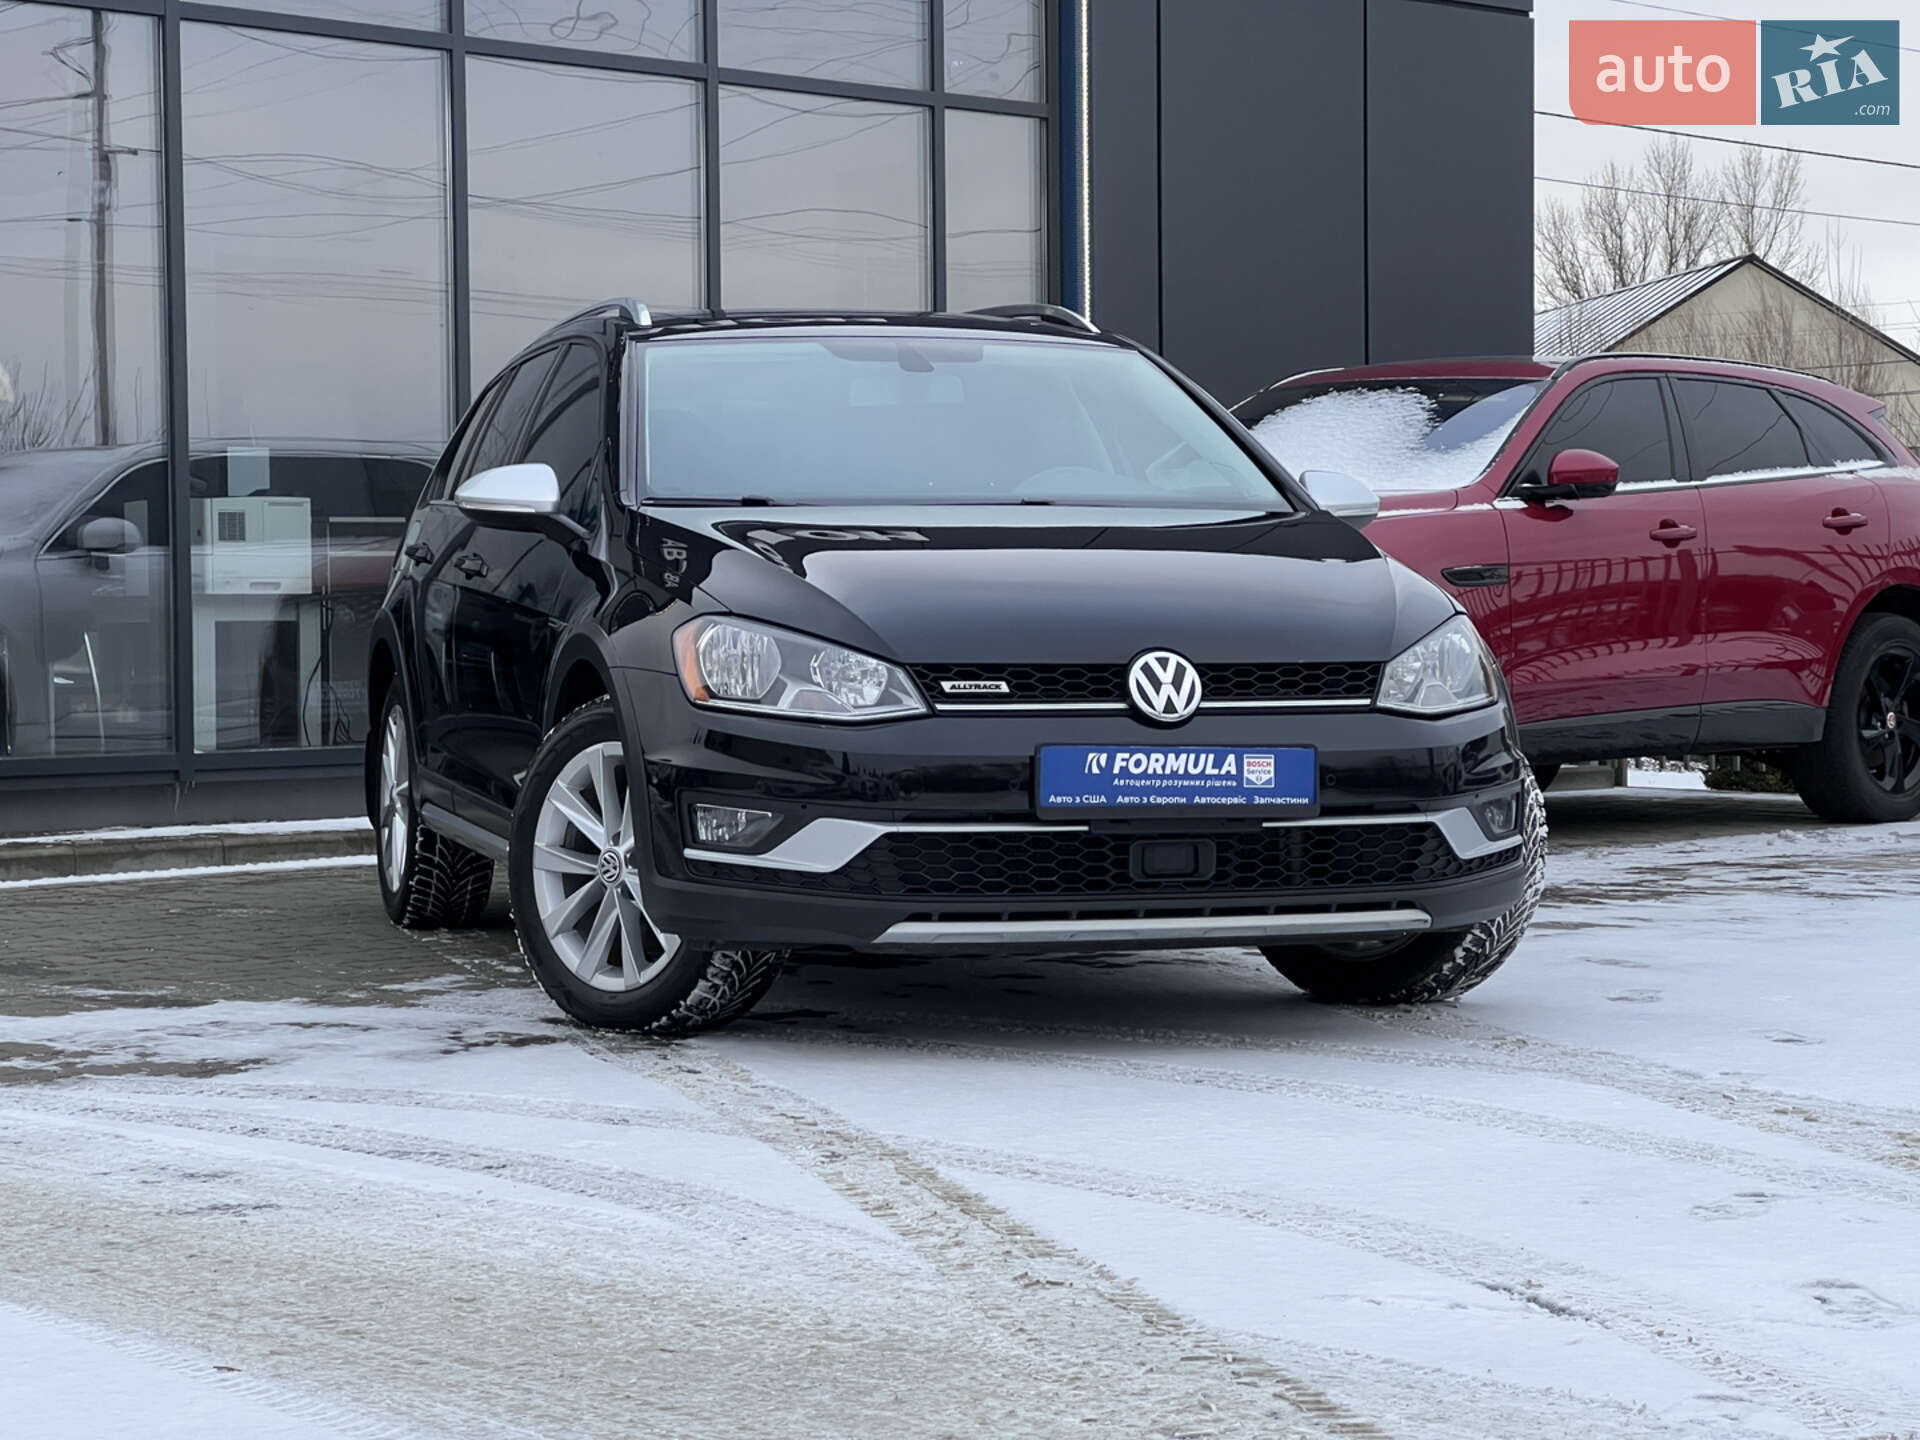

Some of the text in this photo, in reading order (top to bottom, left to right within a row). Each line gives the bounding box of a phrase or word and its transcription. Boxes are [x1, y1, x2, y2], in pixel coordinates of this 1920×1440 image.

[1113, 753, 1237, 775] FORMULA
[1049, 794, 1073, 803] Авто
[1082, 794, 1107, 803] США
[1116, 794, 1141, 803] Авто
[1193, 794, 1246, 805] Автосервіс
[1253, 795, 1309, 804] Запчастини
